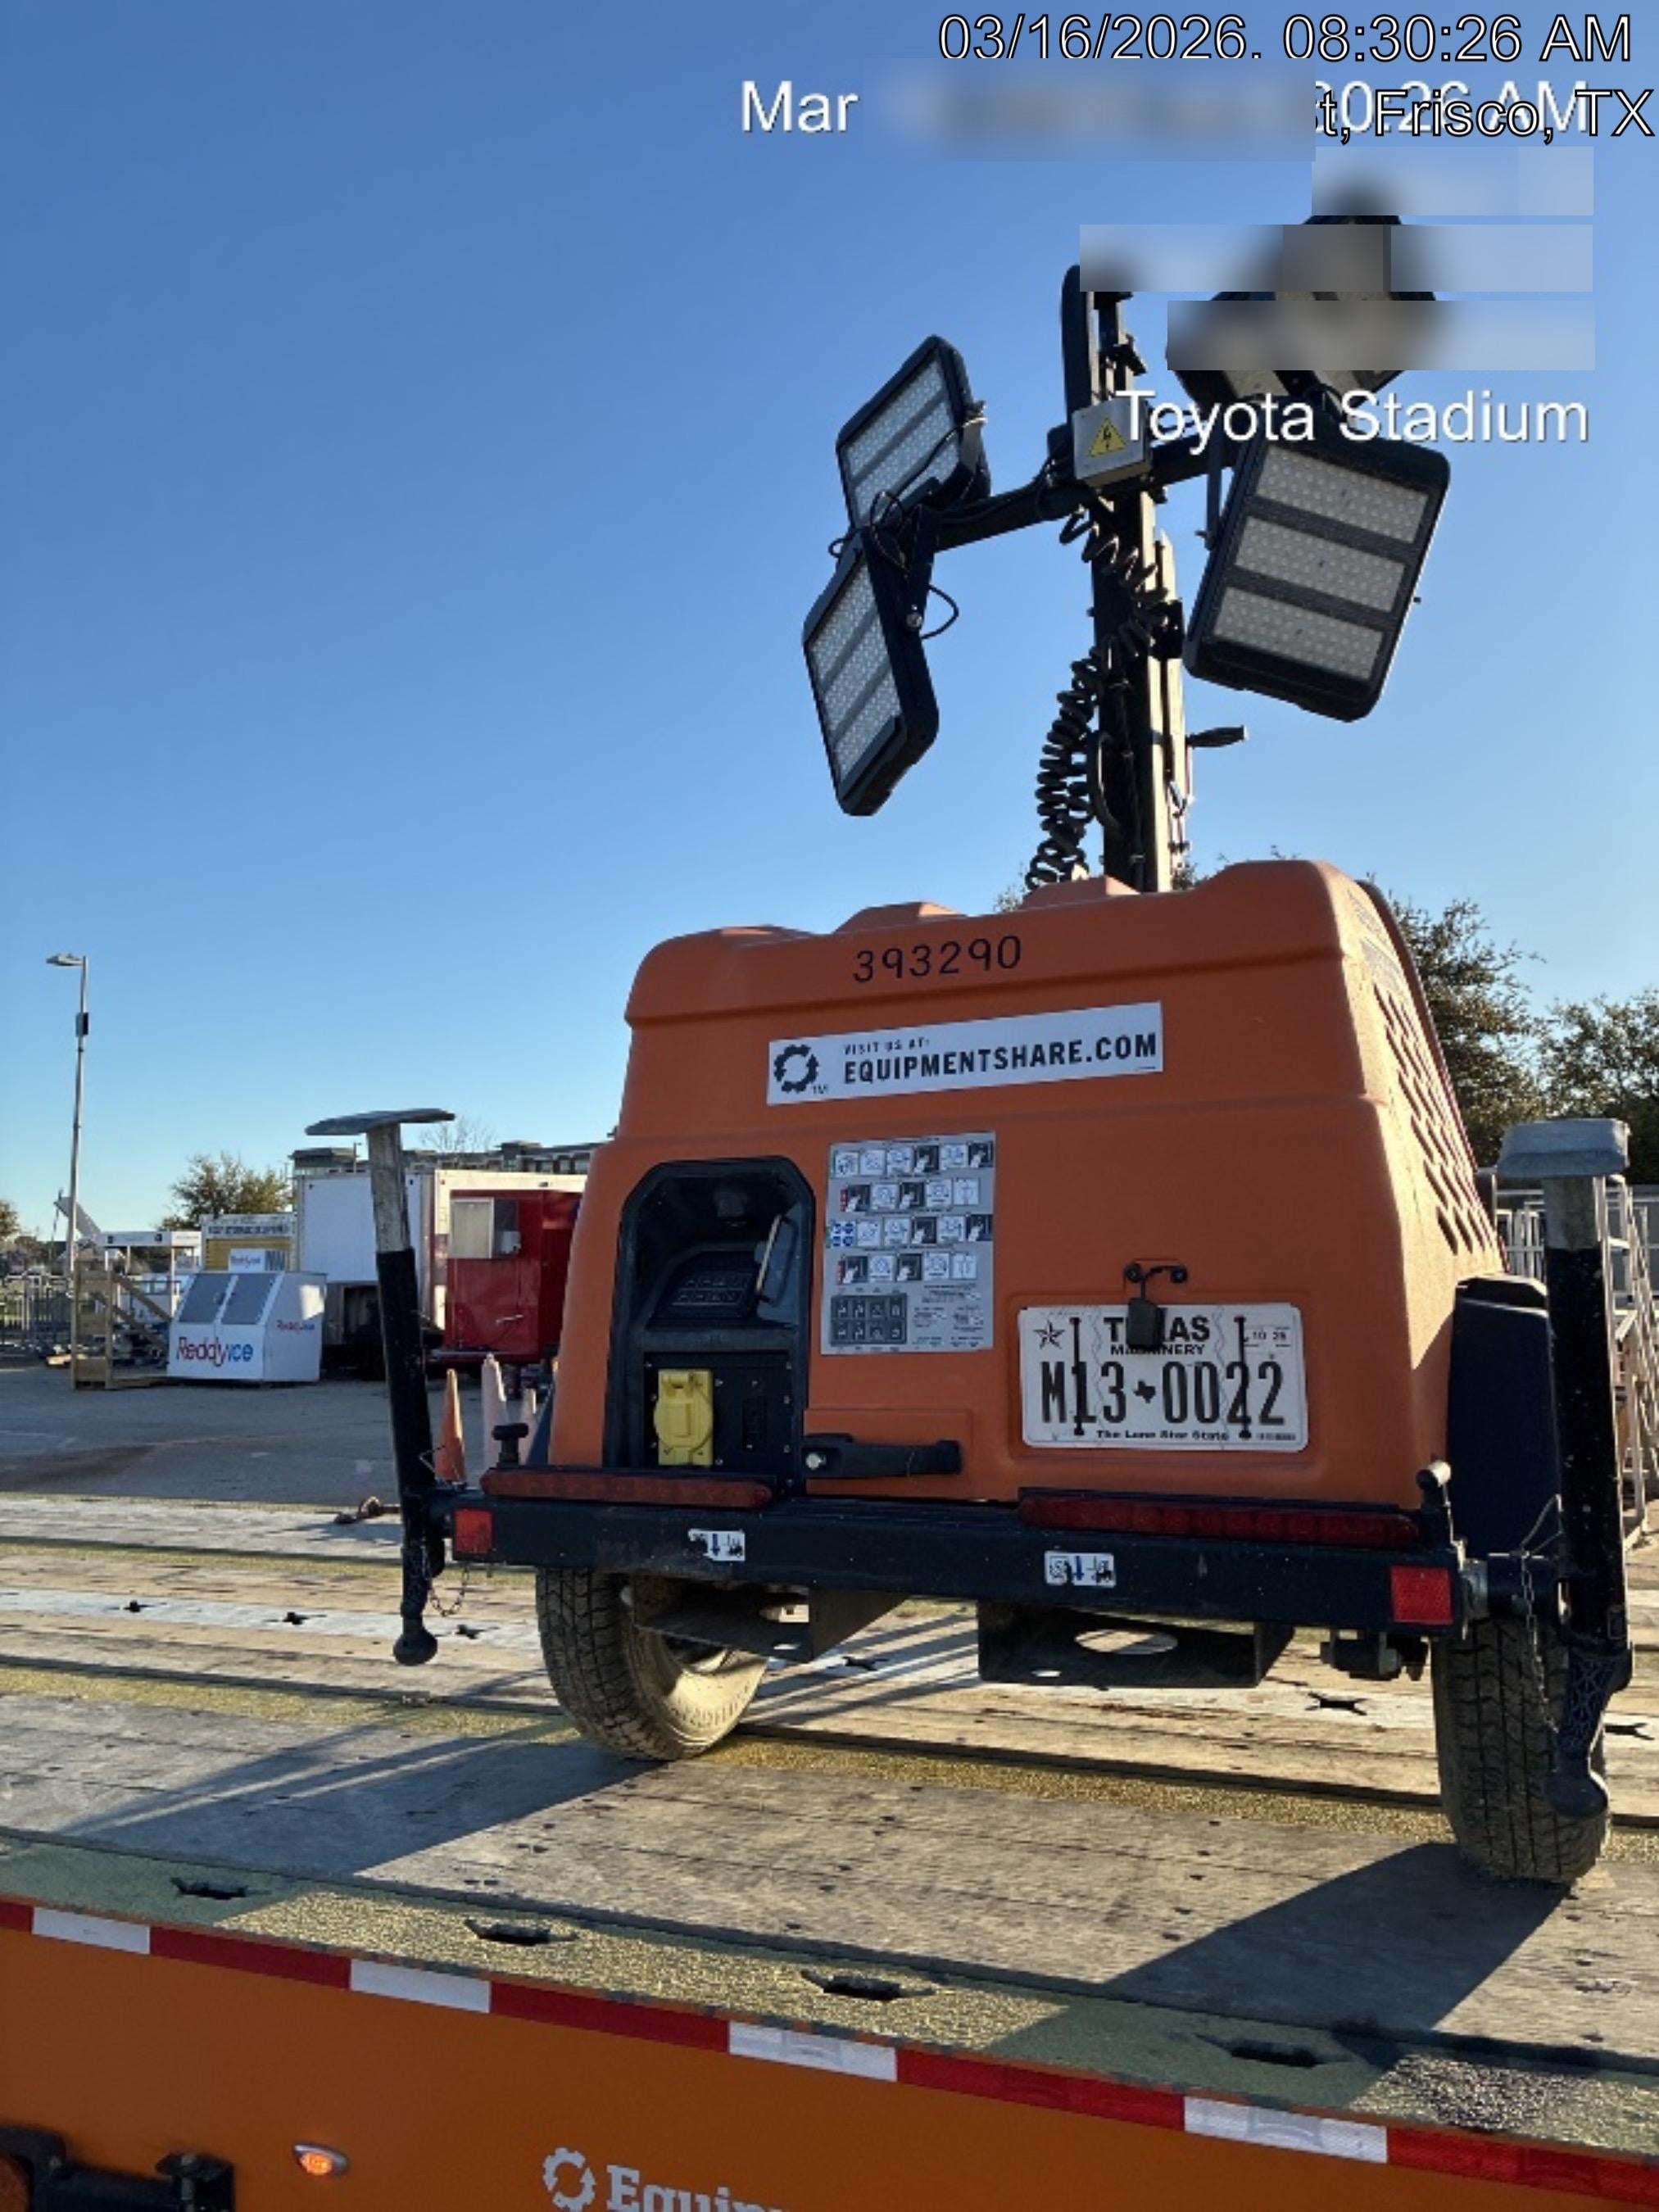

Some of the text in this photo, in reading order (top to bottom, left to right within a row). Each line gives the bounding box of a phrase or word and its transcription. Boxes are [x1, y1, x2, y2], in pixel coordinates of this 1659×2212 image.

[853, 936, 1022, 983] 393290
[844, 1040, 879, 1055] VISIT
[844, 1032, 1157, 1084] EQUIPMENTSHARE.COM
[1104, 1317, 1210, 1343] TAS
[1041, 1361, 1285, 1426] M13 0022
